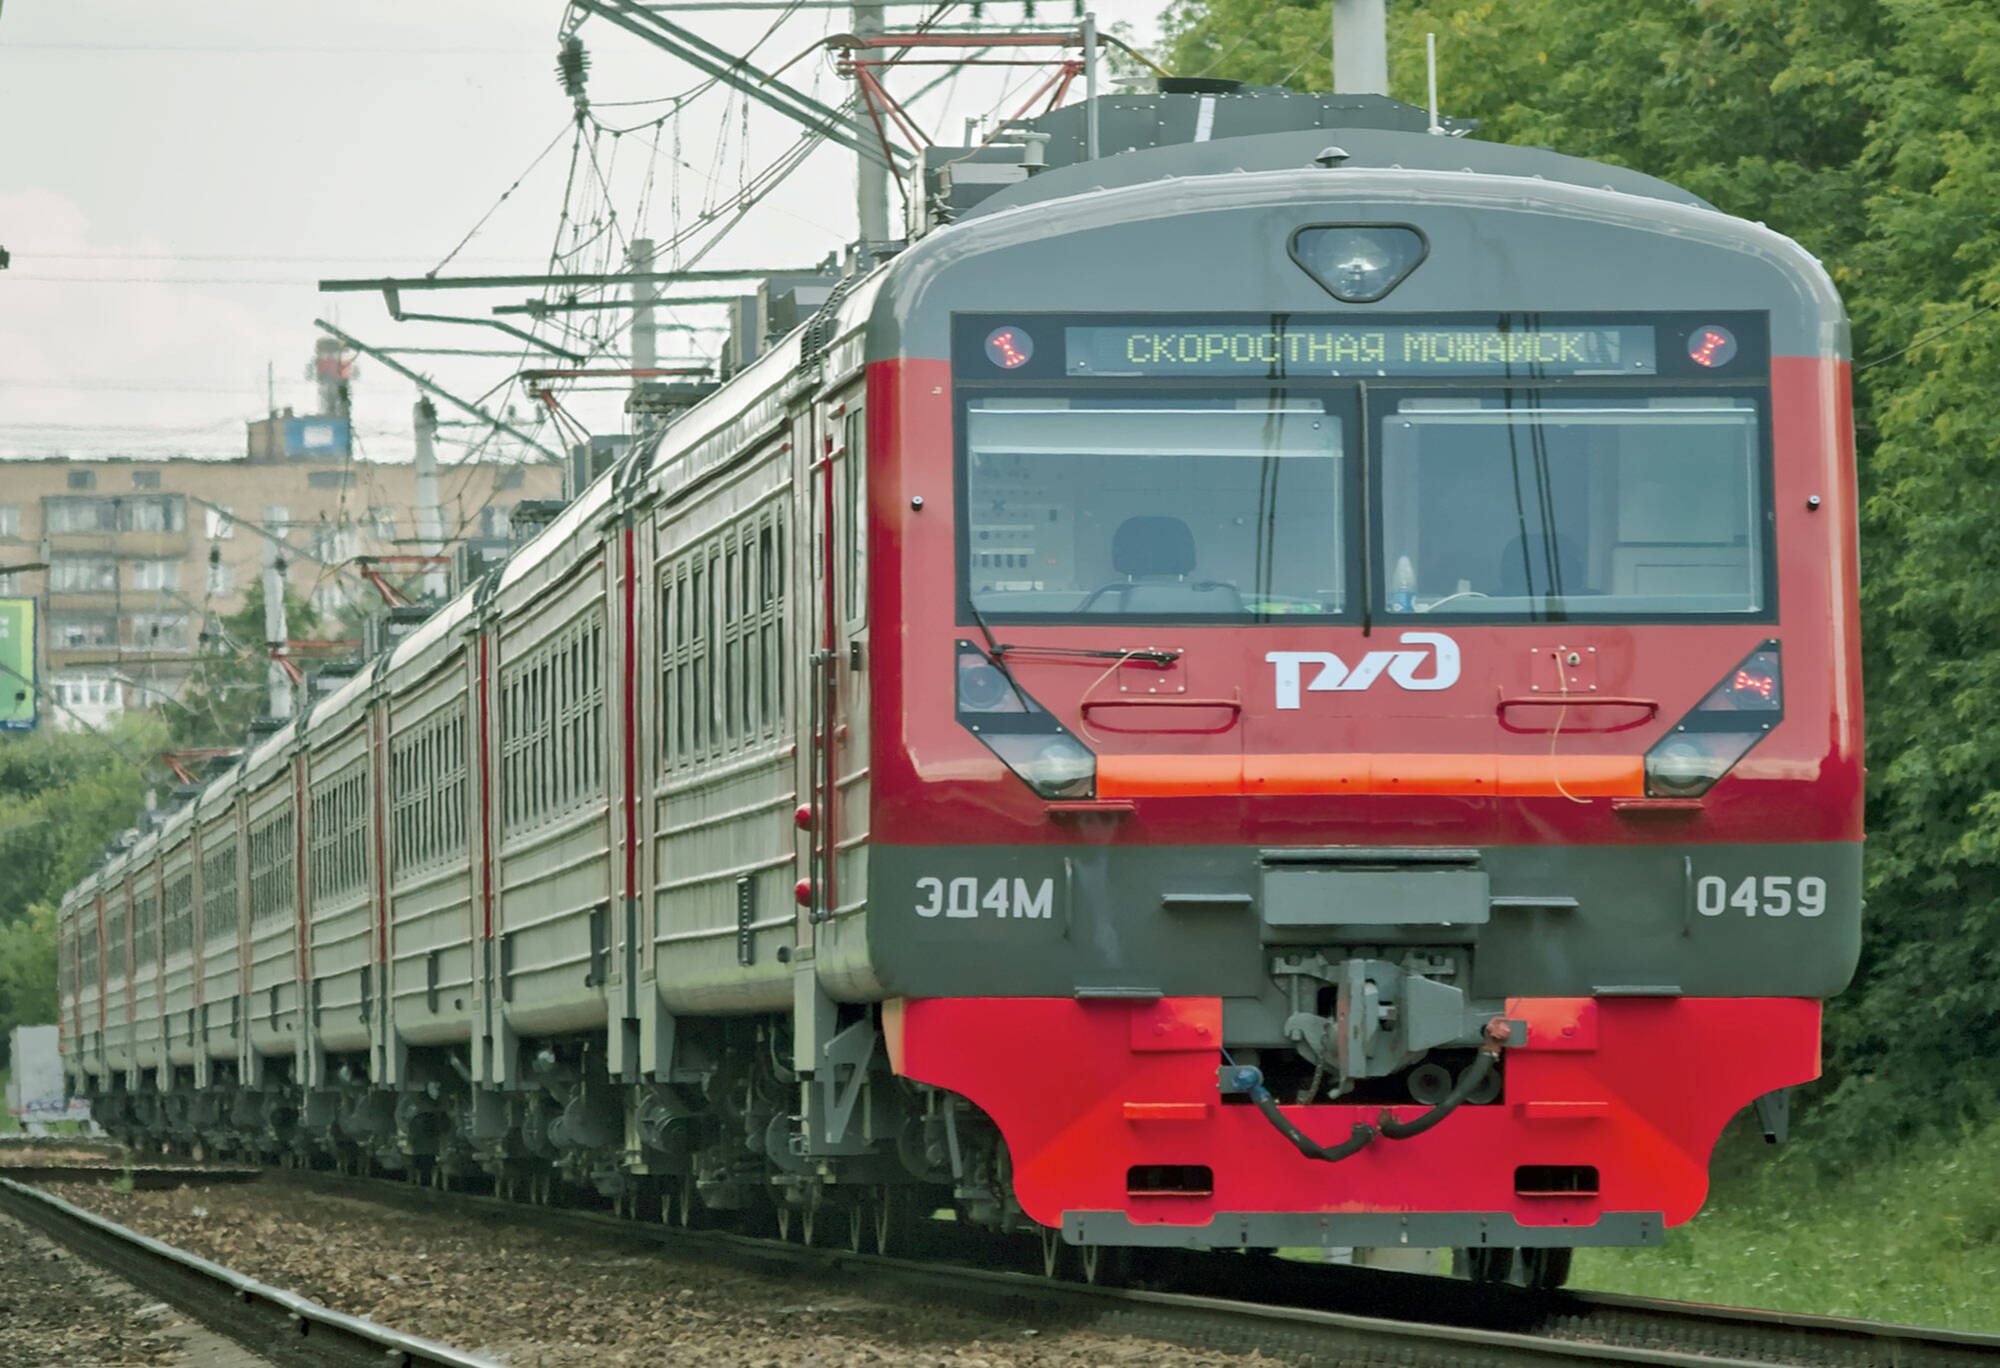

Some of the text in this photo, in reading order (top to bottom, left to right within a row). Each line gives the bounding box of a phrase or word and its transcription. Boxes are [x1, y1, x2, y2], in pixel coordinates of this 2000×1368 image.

[1127, 332, 1585, 363] СКОРОСТНАЯ МОЖАЙСК
[914, 876, 1054, 919] ЭД4М
[1696, 875, 1827, 918] 0459
